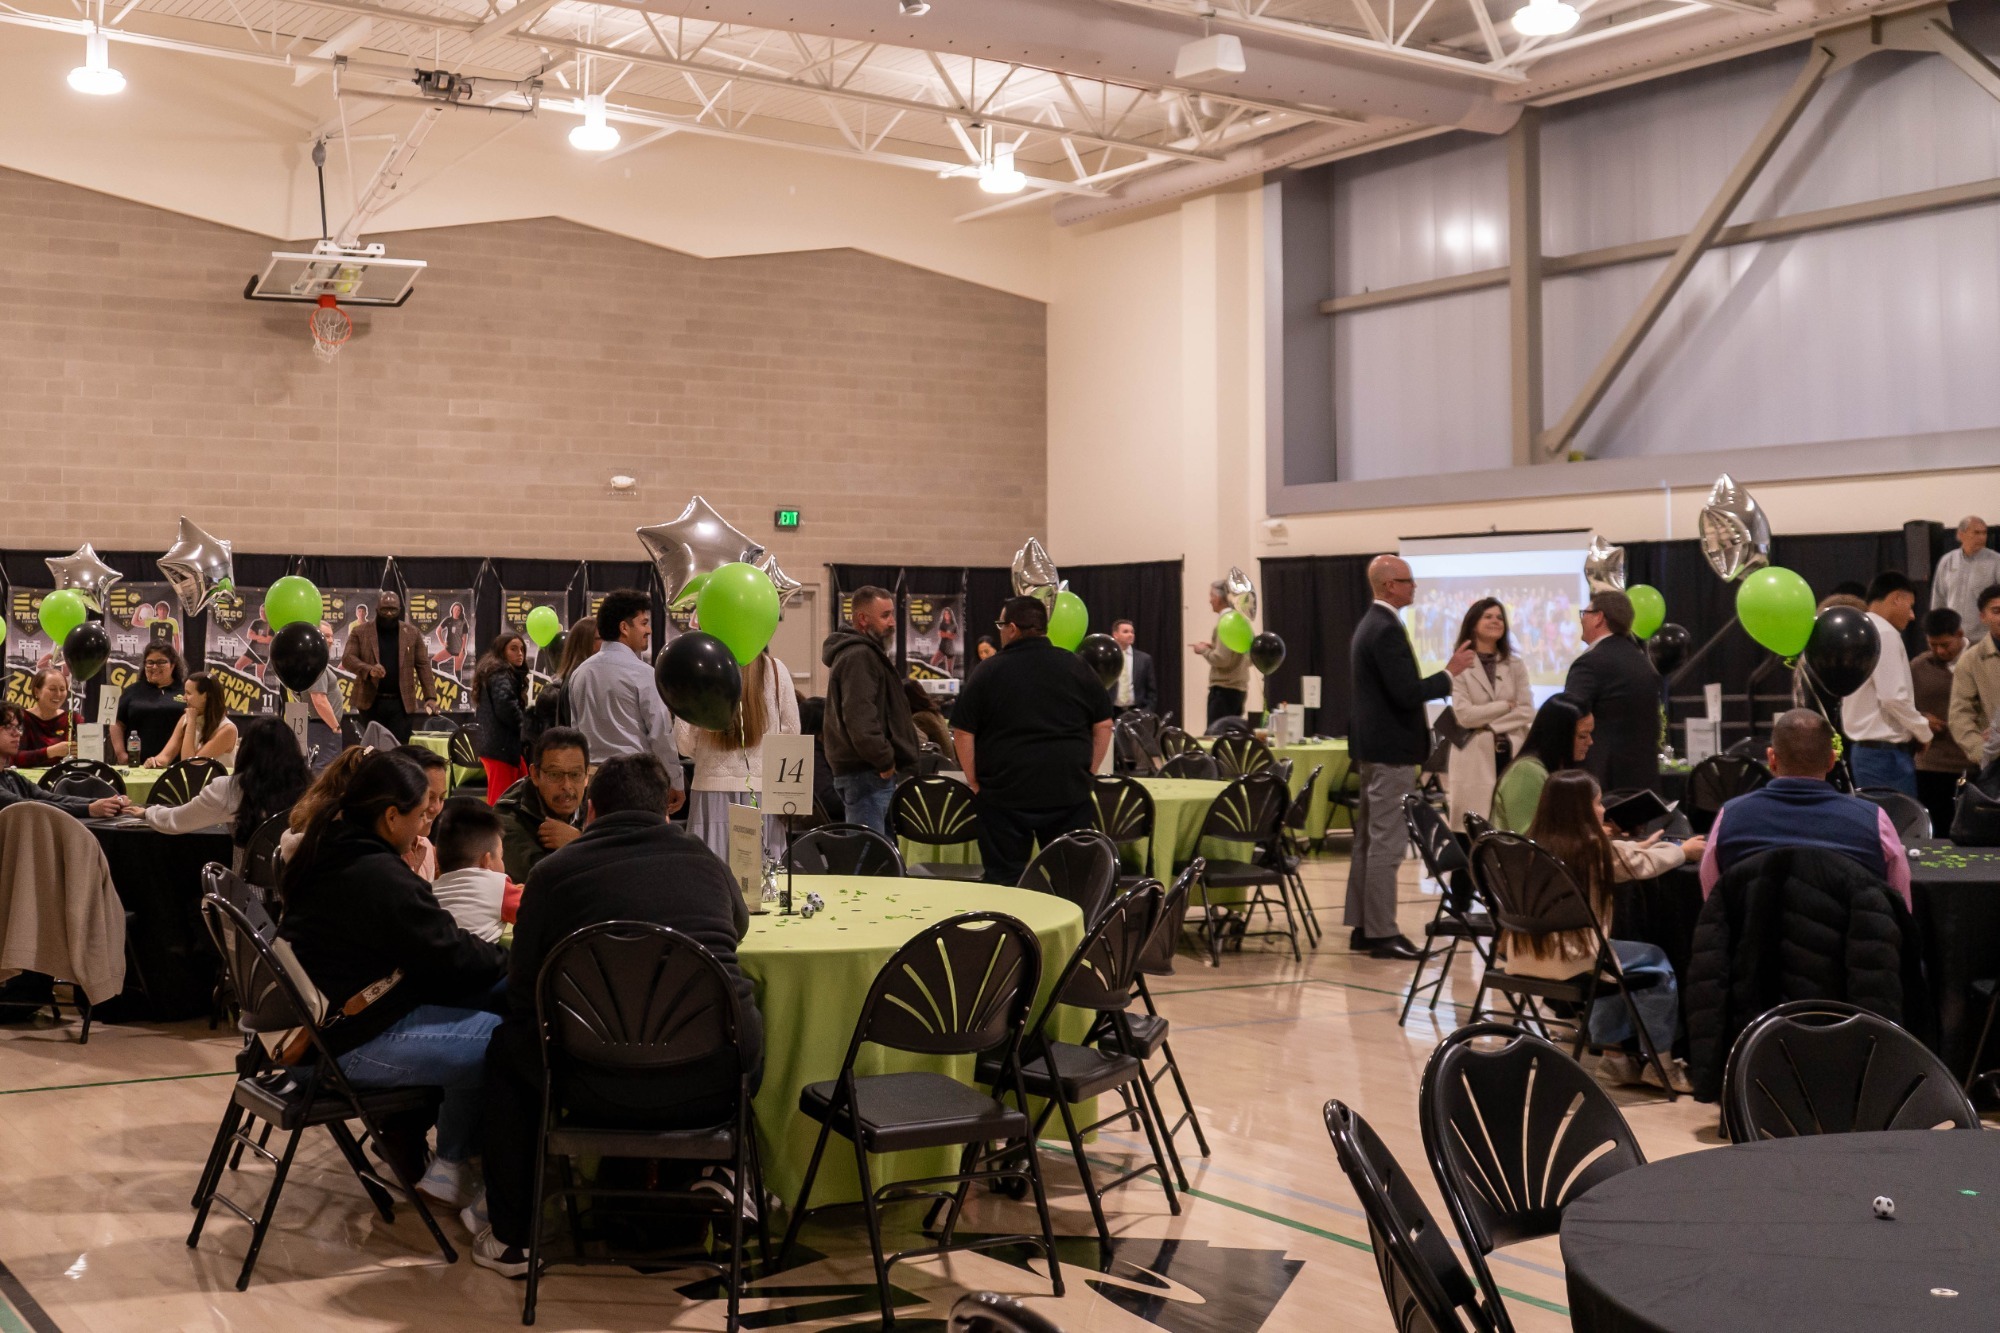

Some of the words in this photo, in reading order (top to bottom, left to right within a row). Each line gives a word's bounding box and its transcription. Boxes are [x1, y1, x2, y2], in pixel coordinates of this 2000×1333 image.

[780, 511, 798, 526] EXIT
[14, 612, 40, 620] TMC
[411, 612, 438, 620] TMCC
[507, 613, 527, 621] TMC
[103, 696, 117, 710] 12
[262, 694, 273, 707] 11
[461, 690, 468, 703] 8
[67, 697, 81, 711] 12
[293, 717, 304, 736] 13
[774, 757, 805, 784] 14
